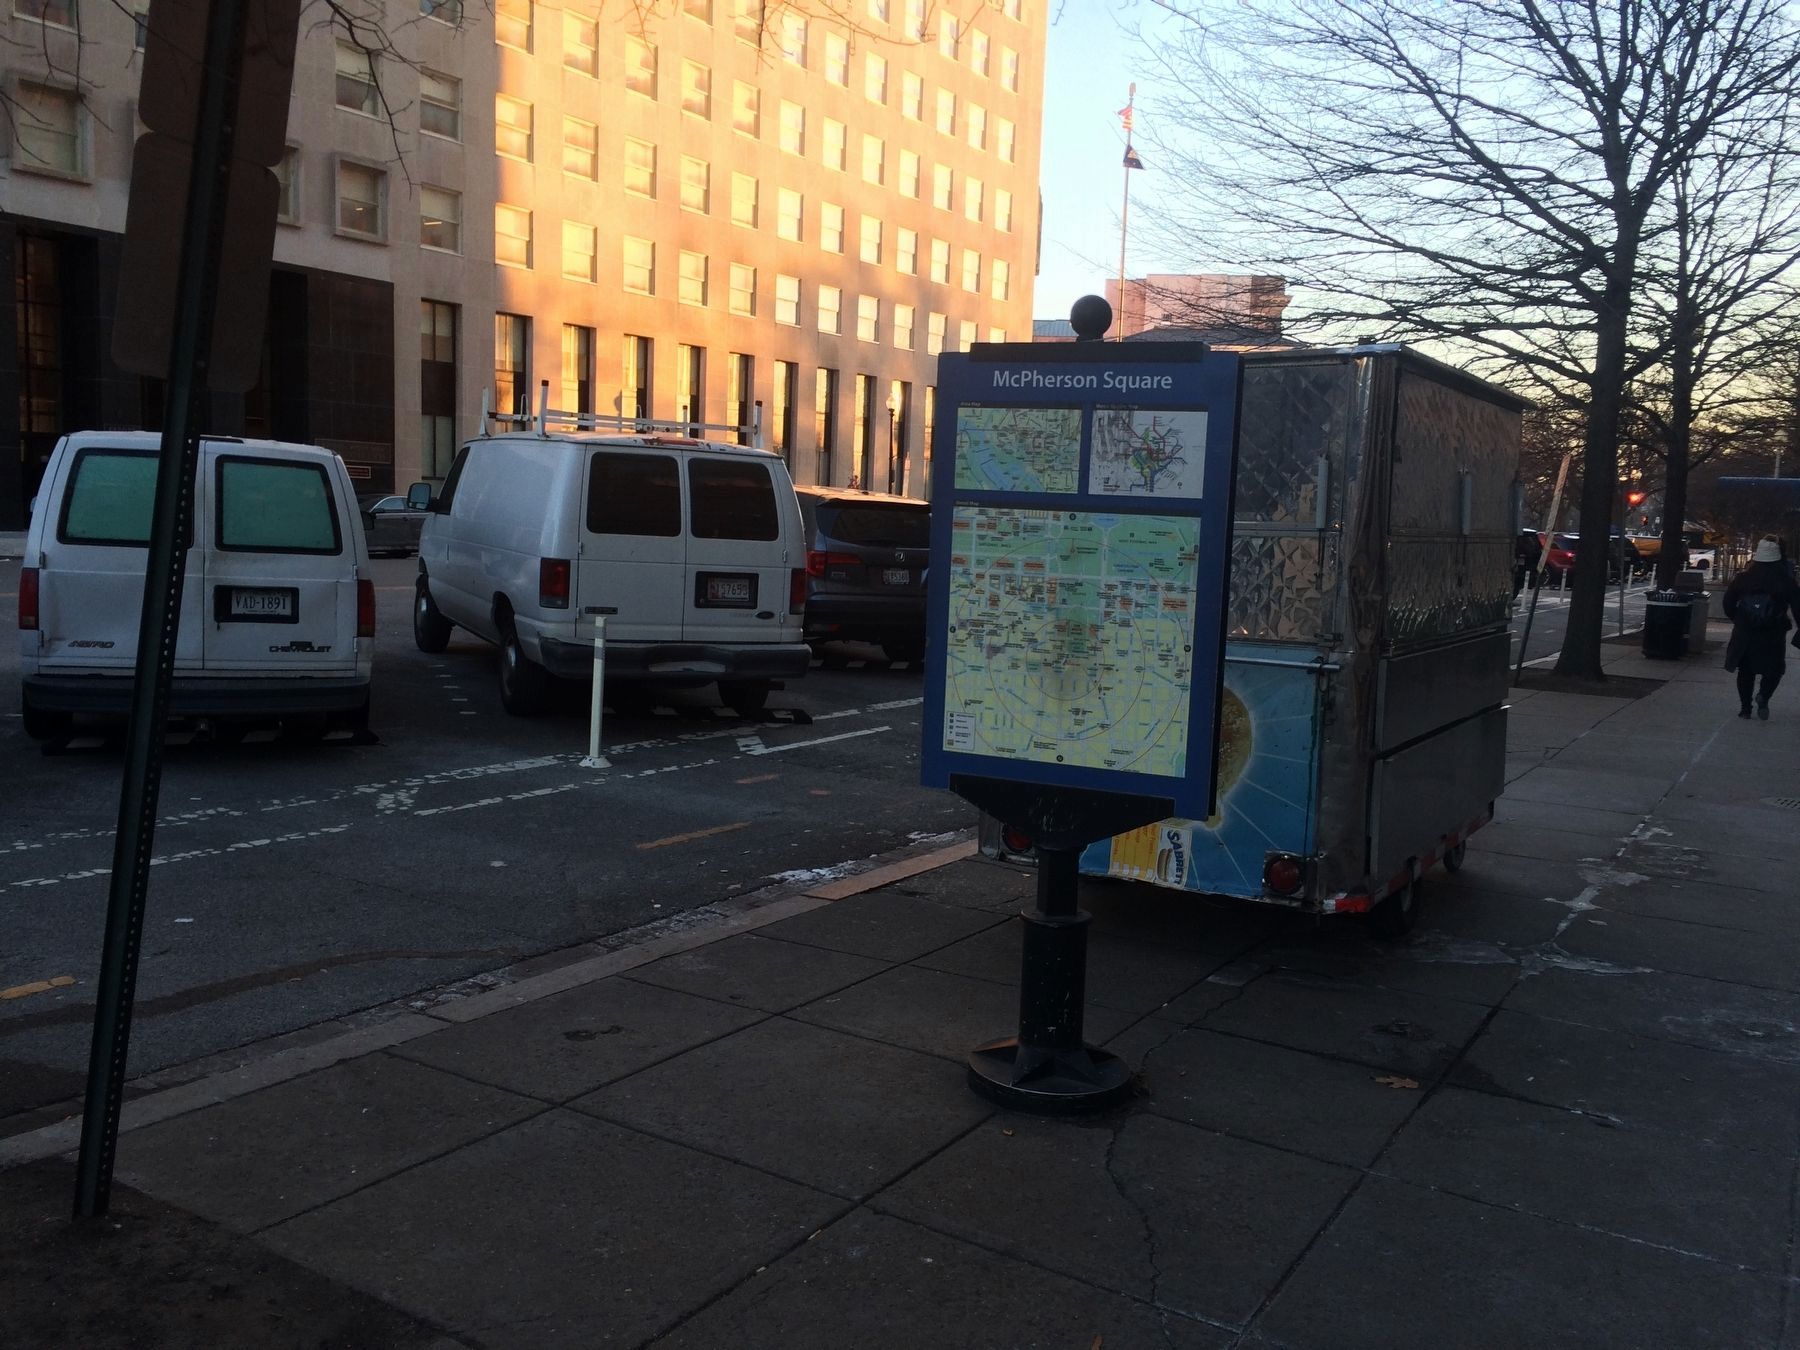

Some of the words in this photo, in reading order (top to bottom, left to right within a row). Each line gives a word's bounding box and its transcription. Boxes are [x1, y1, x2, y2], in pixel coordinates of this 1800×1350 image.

[993, 370, 1097, 388] McPherson
[1103, 371, 1173, 393] Square
[235, 596, 286, 610] VAD-1891
[269, 645, 331, 653] CHEVROLET
[1167, 829, 1184, 885] SABRETT
